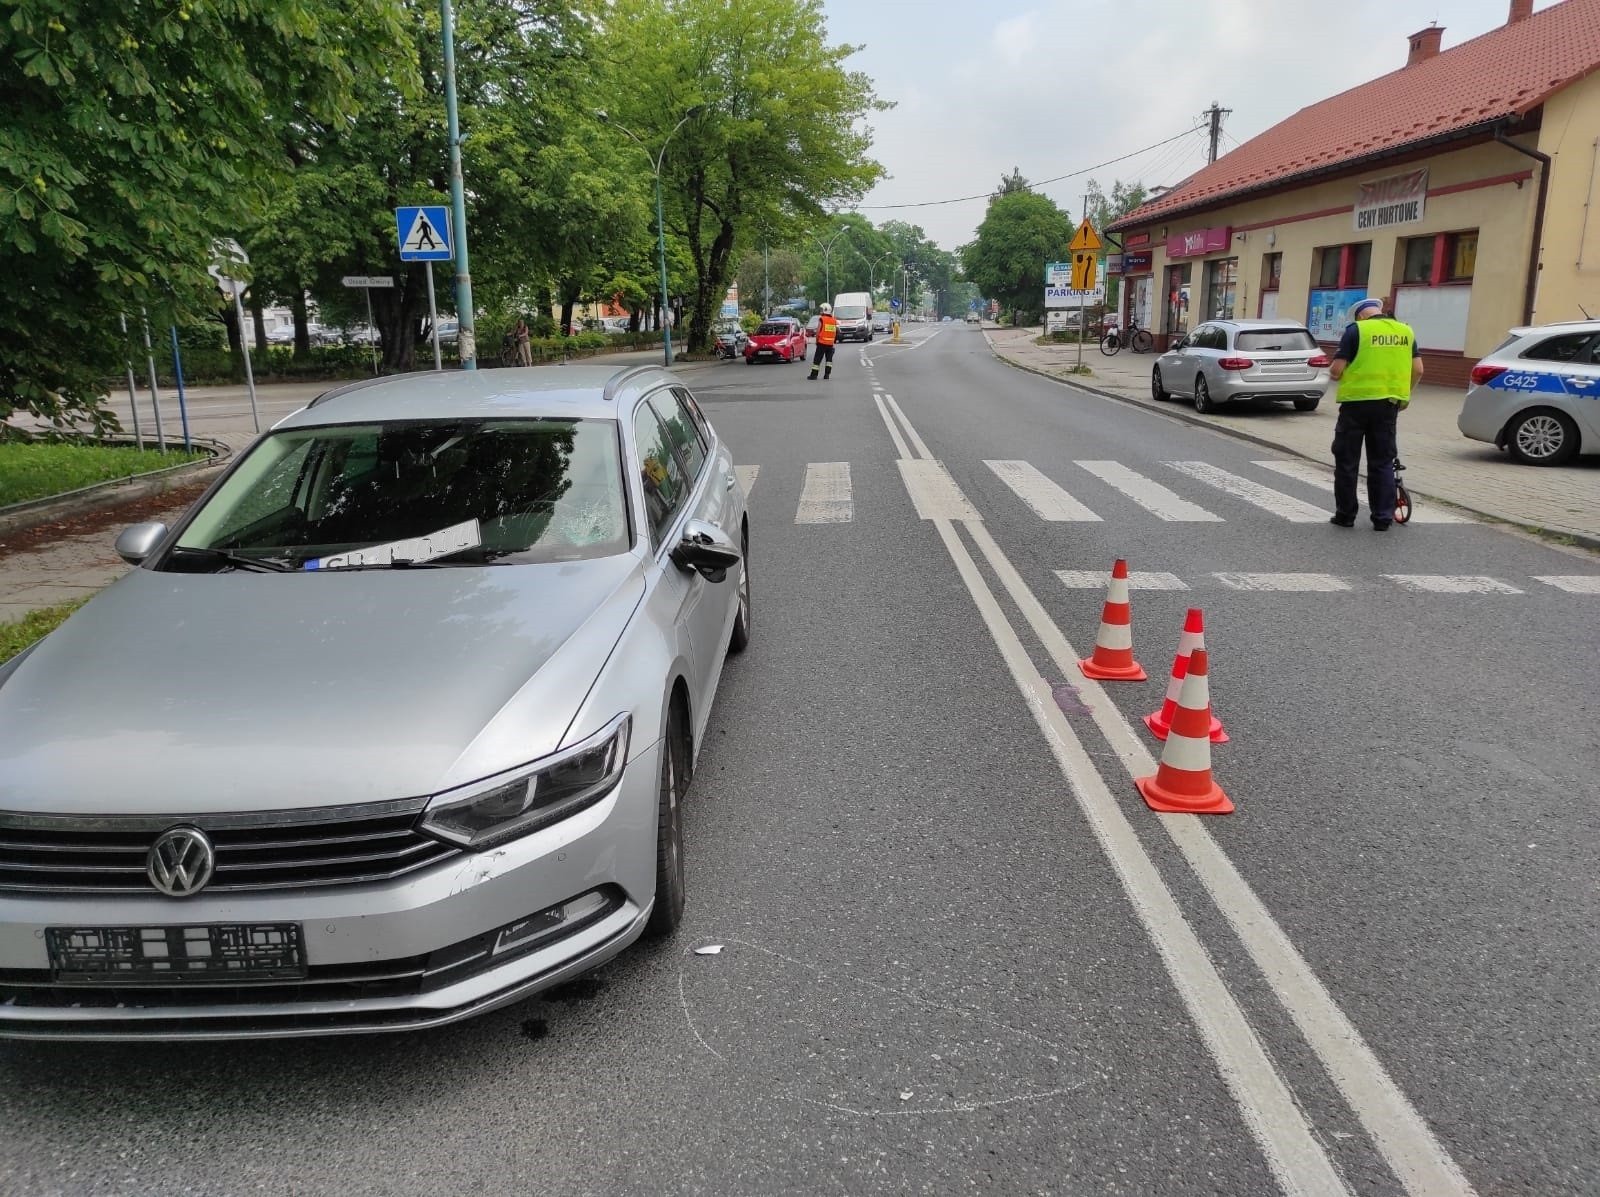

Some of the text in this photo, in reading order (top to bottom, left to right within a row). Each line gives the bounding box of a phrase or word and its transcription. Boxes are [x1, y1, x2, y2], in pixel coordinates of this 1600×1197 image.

[1358, 201, 1418, 229] CENY HURTOWE
[1047, 288, 1090, 297] PARKING
[1372, 335, 1409, 347] POLICJA
[1503, 373, 1538, 388] G425
